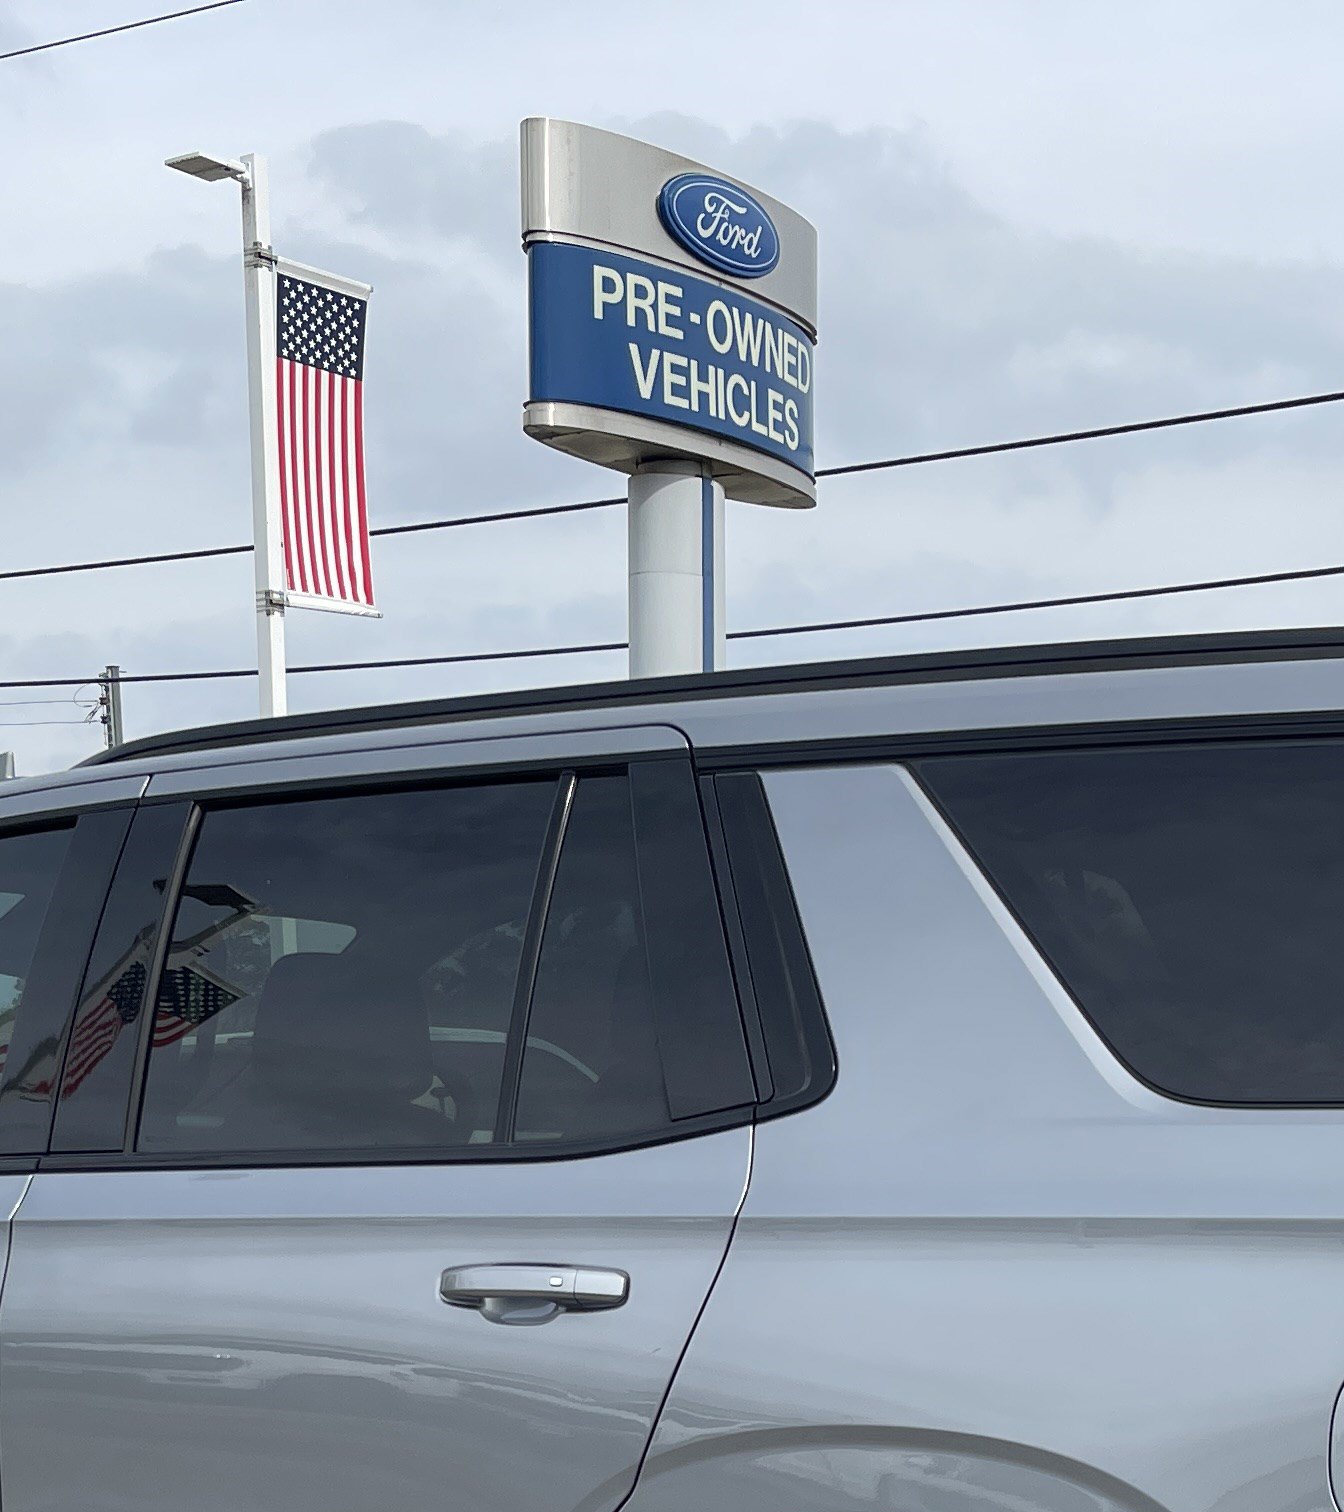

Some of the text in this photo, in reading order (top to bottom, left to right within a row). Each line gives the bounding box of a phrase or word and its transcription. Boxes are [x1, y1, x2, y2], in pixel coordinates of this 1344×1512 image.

[696, 191, 763, 259] Ford
[592, 264, 811, 395] PRE-OWNED
[628, 342, 800, 451] VEHICLES
